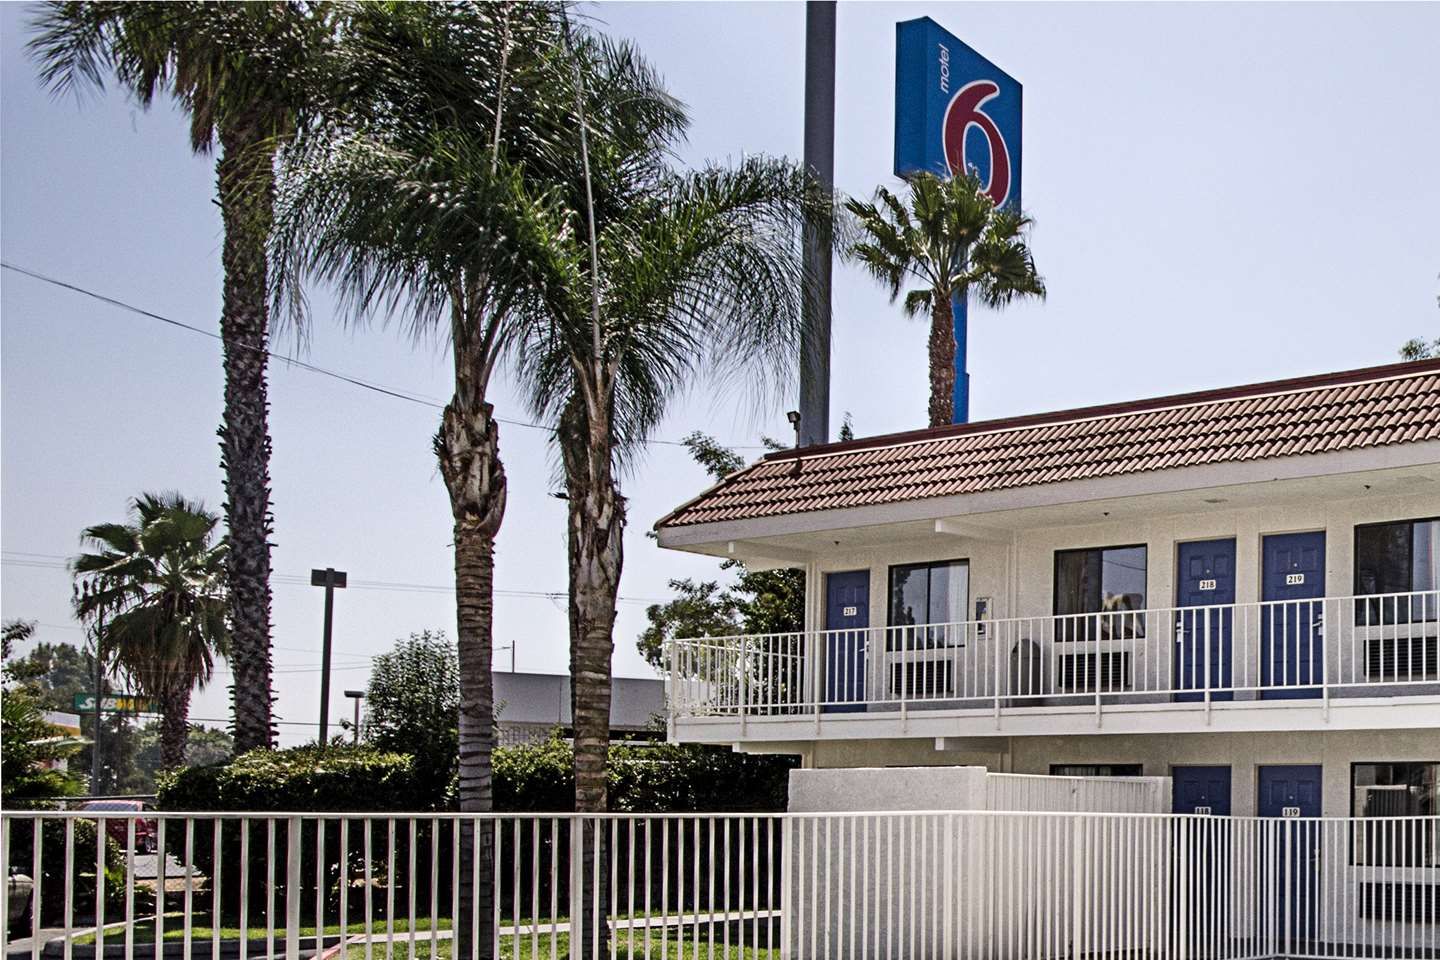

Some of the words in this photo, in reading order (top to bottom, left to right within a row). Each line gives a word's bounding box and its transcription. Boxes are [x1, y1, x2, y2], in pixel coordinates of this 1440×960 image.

[938, 43, 950, 94] motel
[942, 79, 1011, 208] 6
[1287, 575, 1303, 584] 219
[1201, 581, 1215, 589] 218
[1284, 808, 1298, 816] 119
